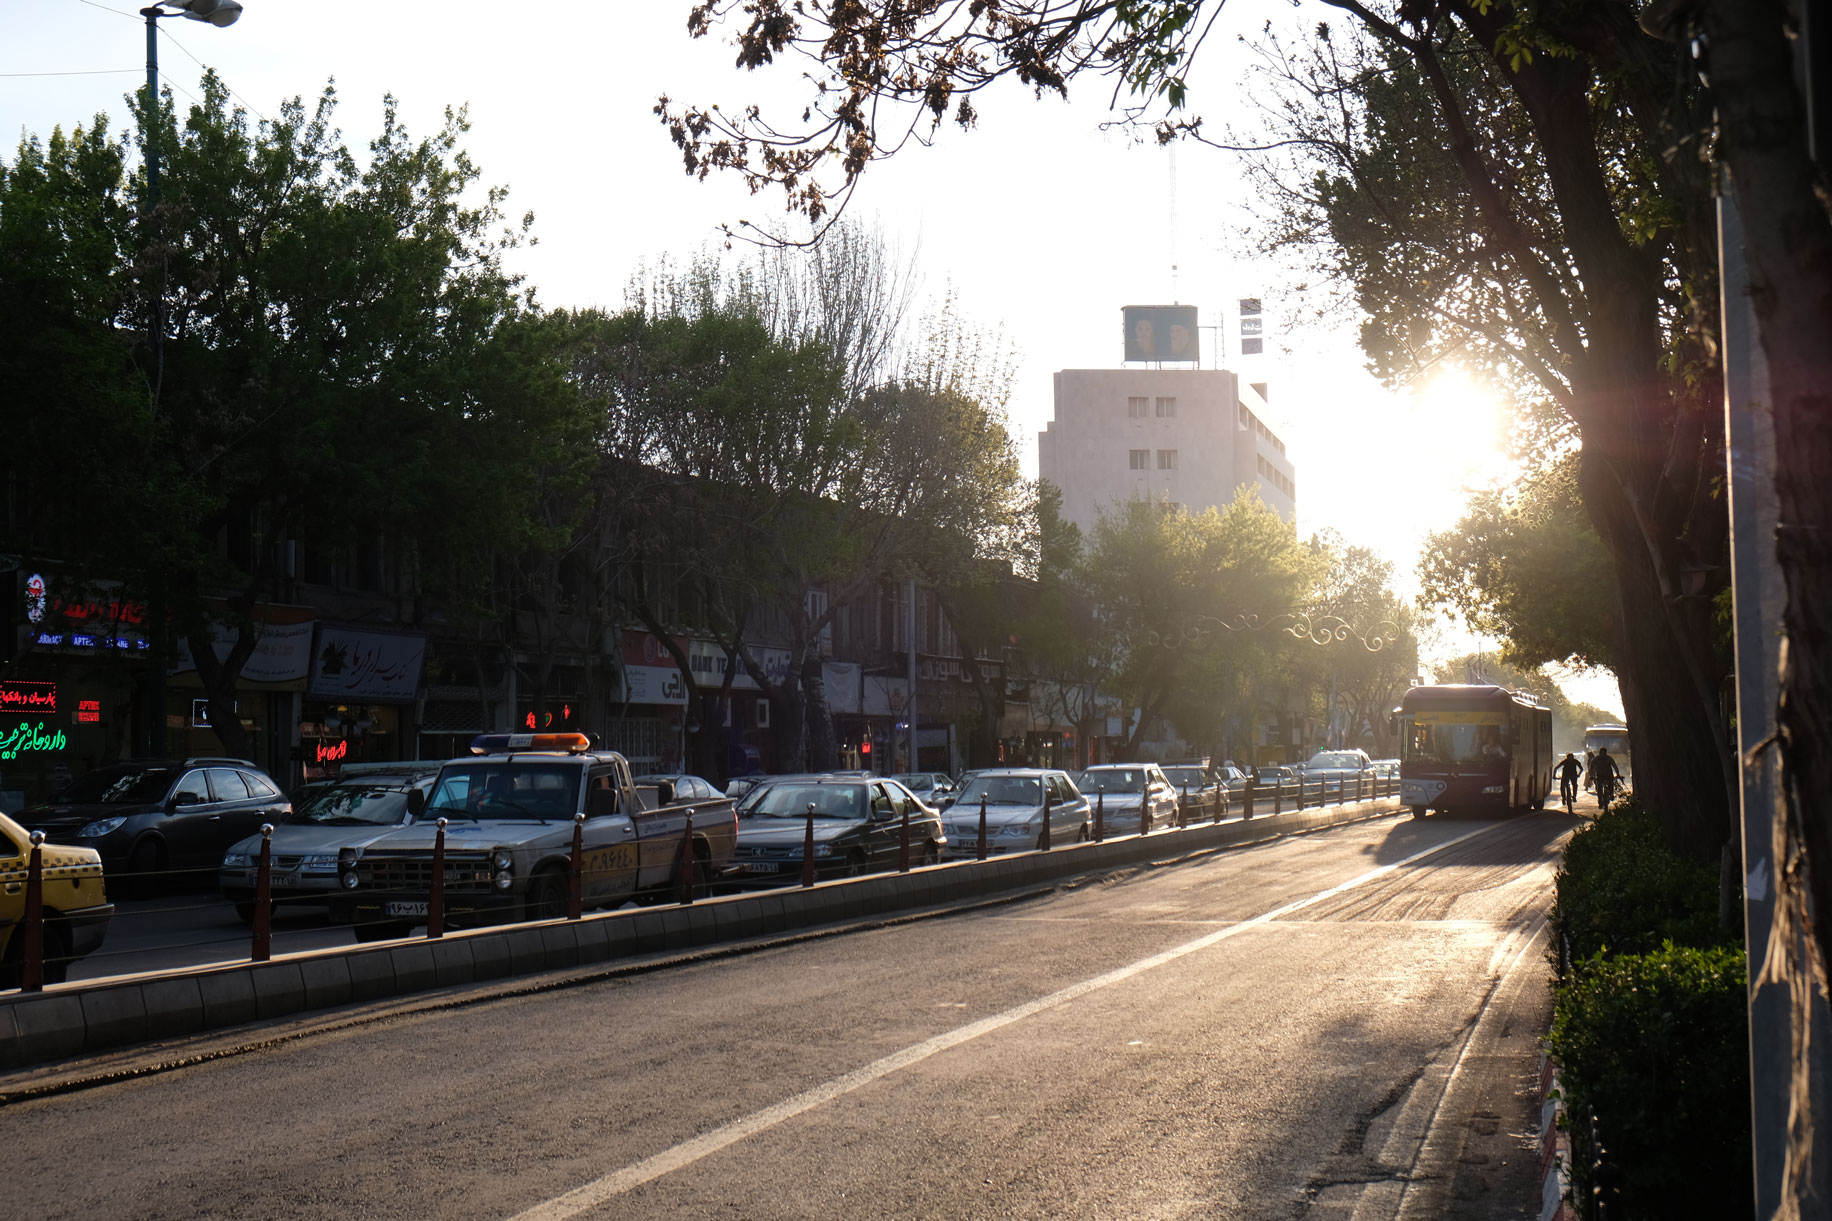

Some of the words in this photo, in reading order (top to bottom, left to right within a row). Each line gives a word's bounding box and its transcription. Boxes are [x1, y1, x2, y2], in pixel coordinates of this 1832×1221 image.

[657, 640, 670, 658] LG
[691, 654, 713, 673] BANK
[22, 694, 28, 705] و
